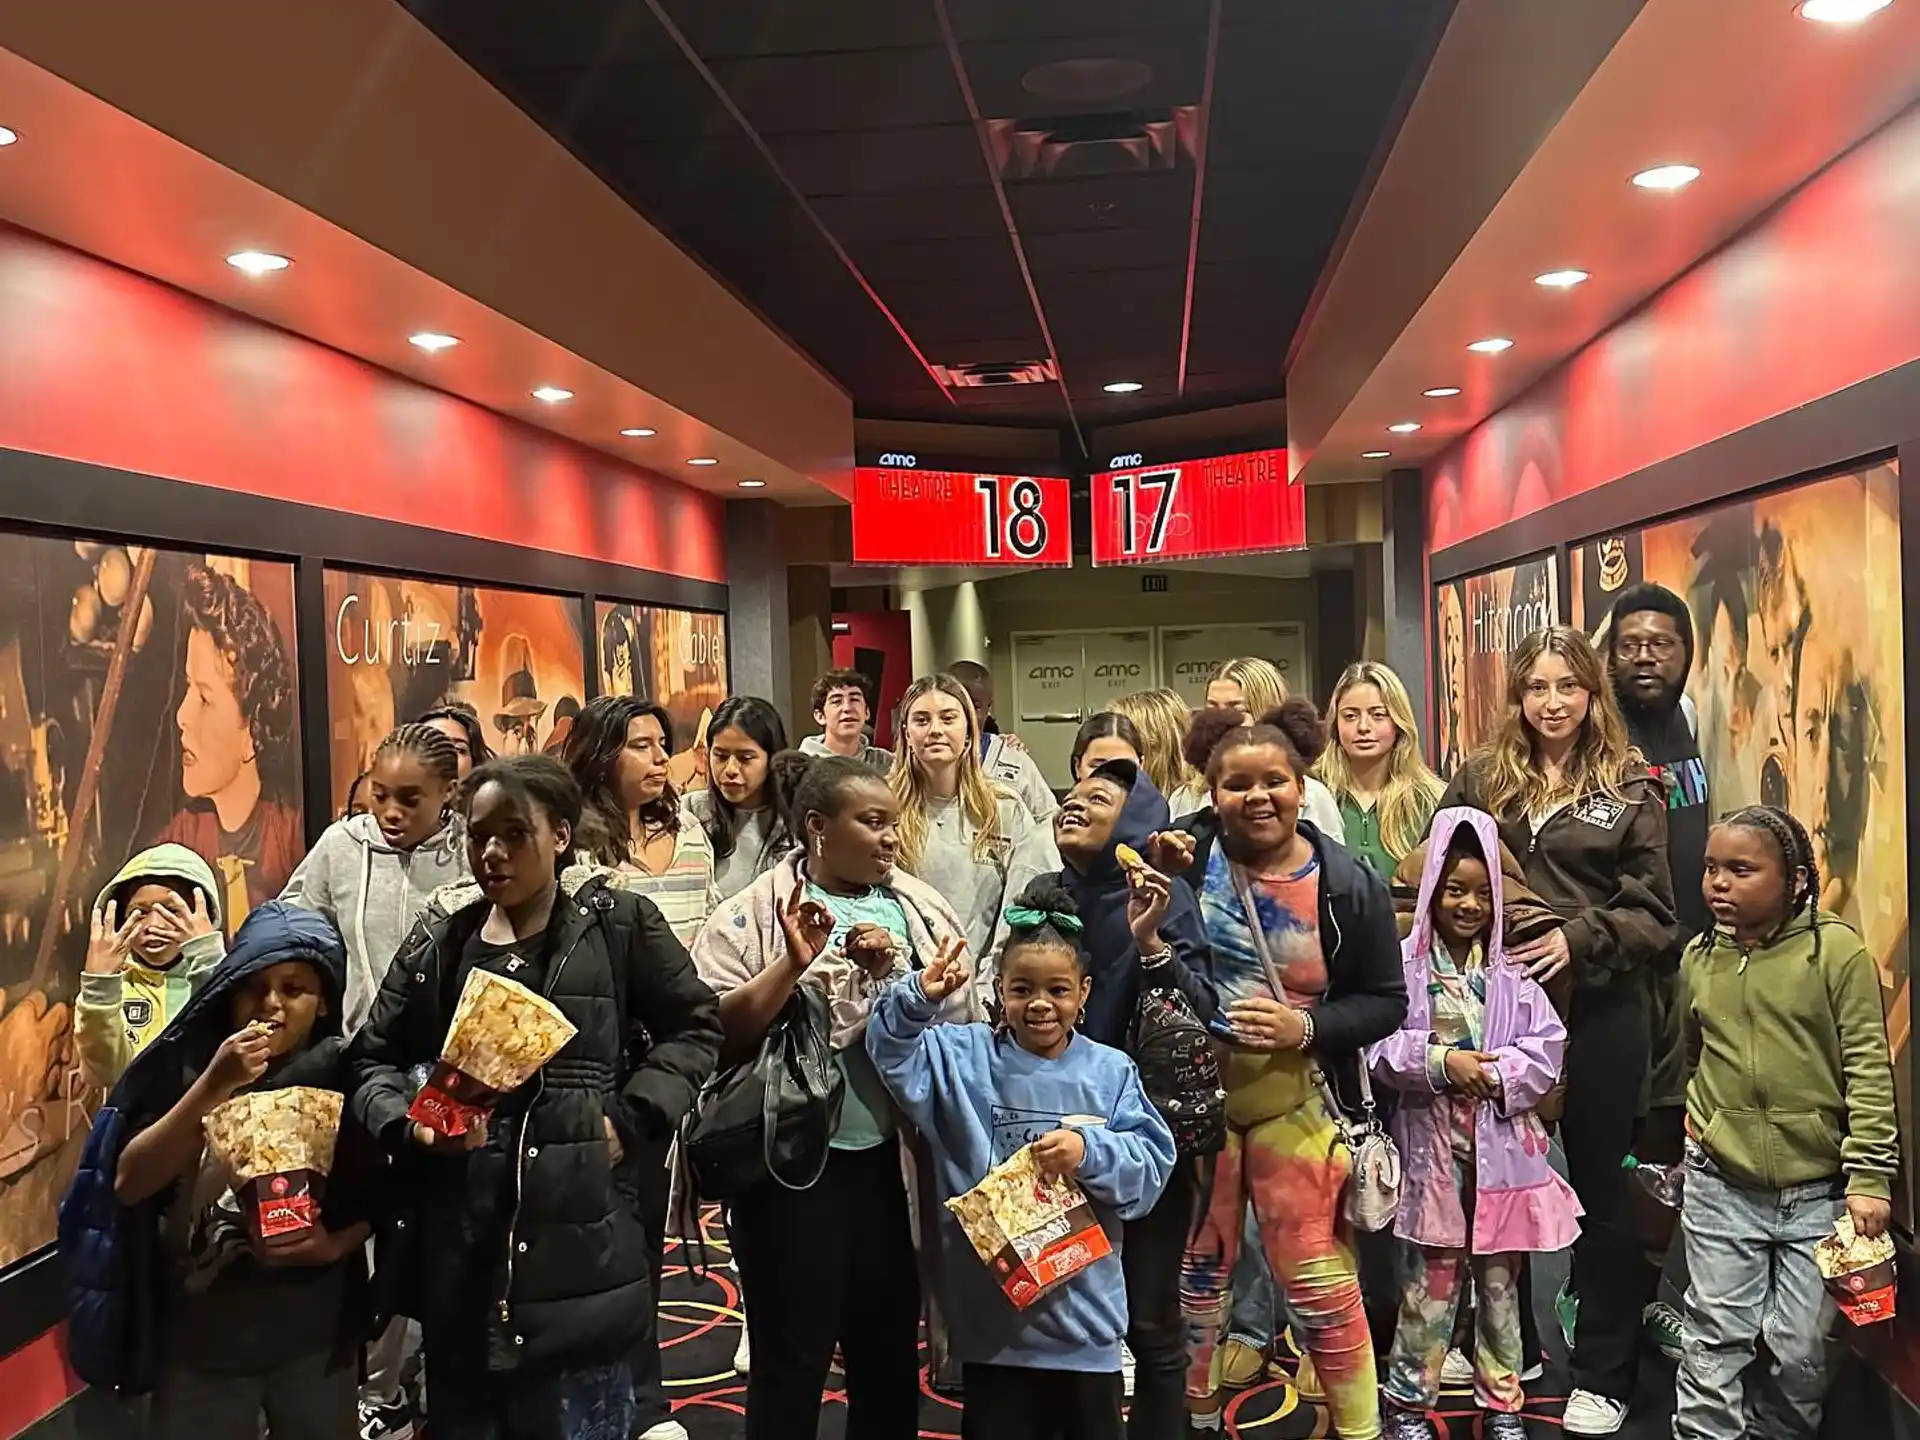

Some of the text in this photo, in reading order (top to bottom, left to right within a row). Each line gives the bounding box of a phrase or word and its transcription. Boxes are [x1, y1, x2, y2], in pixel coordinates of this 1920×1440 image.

[879, 453, 917, 467] amc
[1110, 453, 1143, 468] amc
[1112, 455, 1278, 555] 17 THEATRE
[878, 472, 1048, 559] THEATRE 18
[337, 594, 440, 665] Curtiz
[1029, 665, 1075, 679] amc
[1094, 664, 1141, 678] amc
